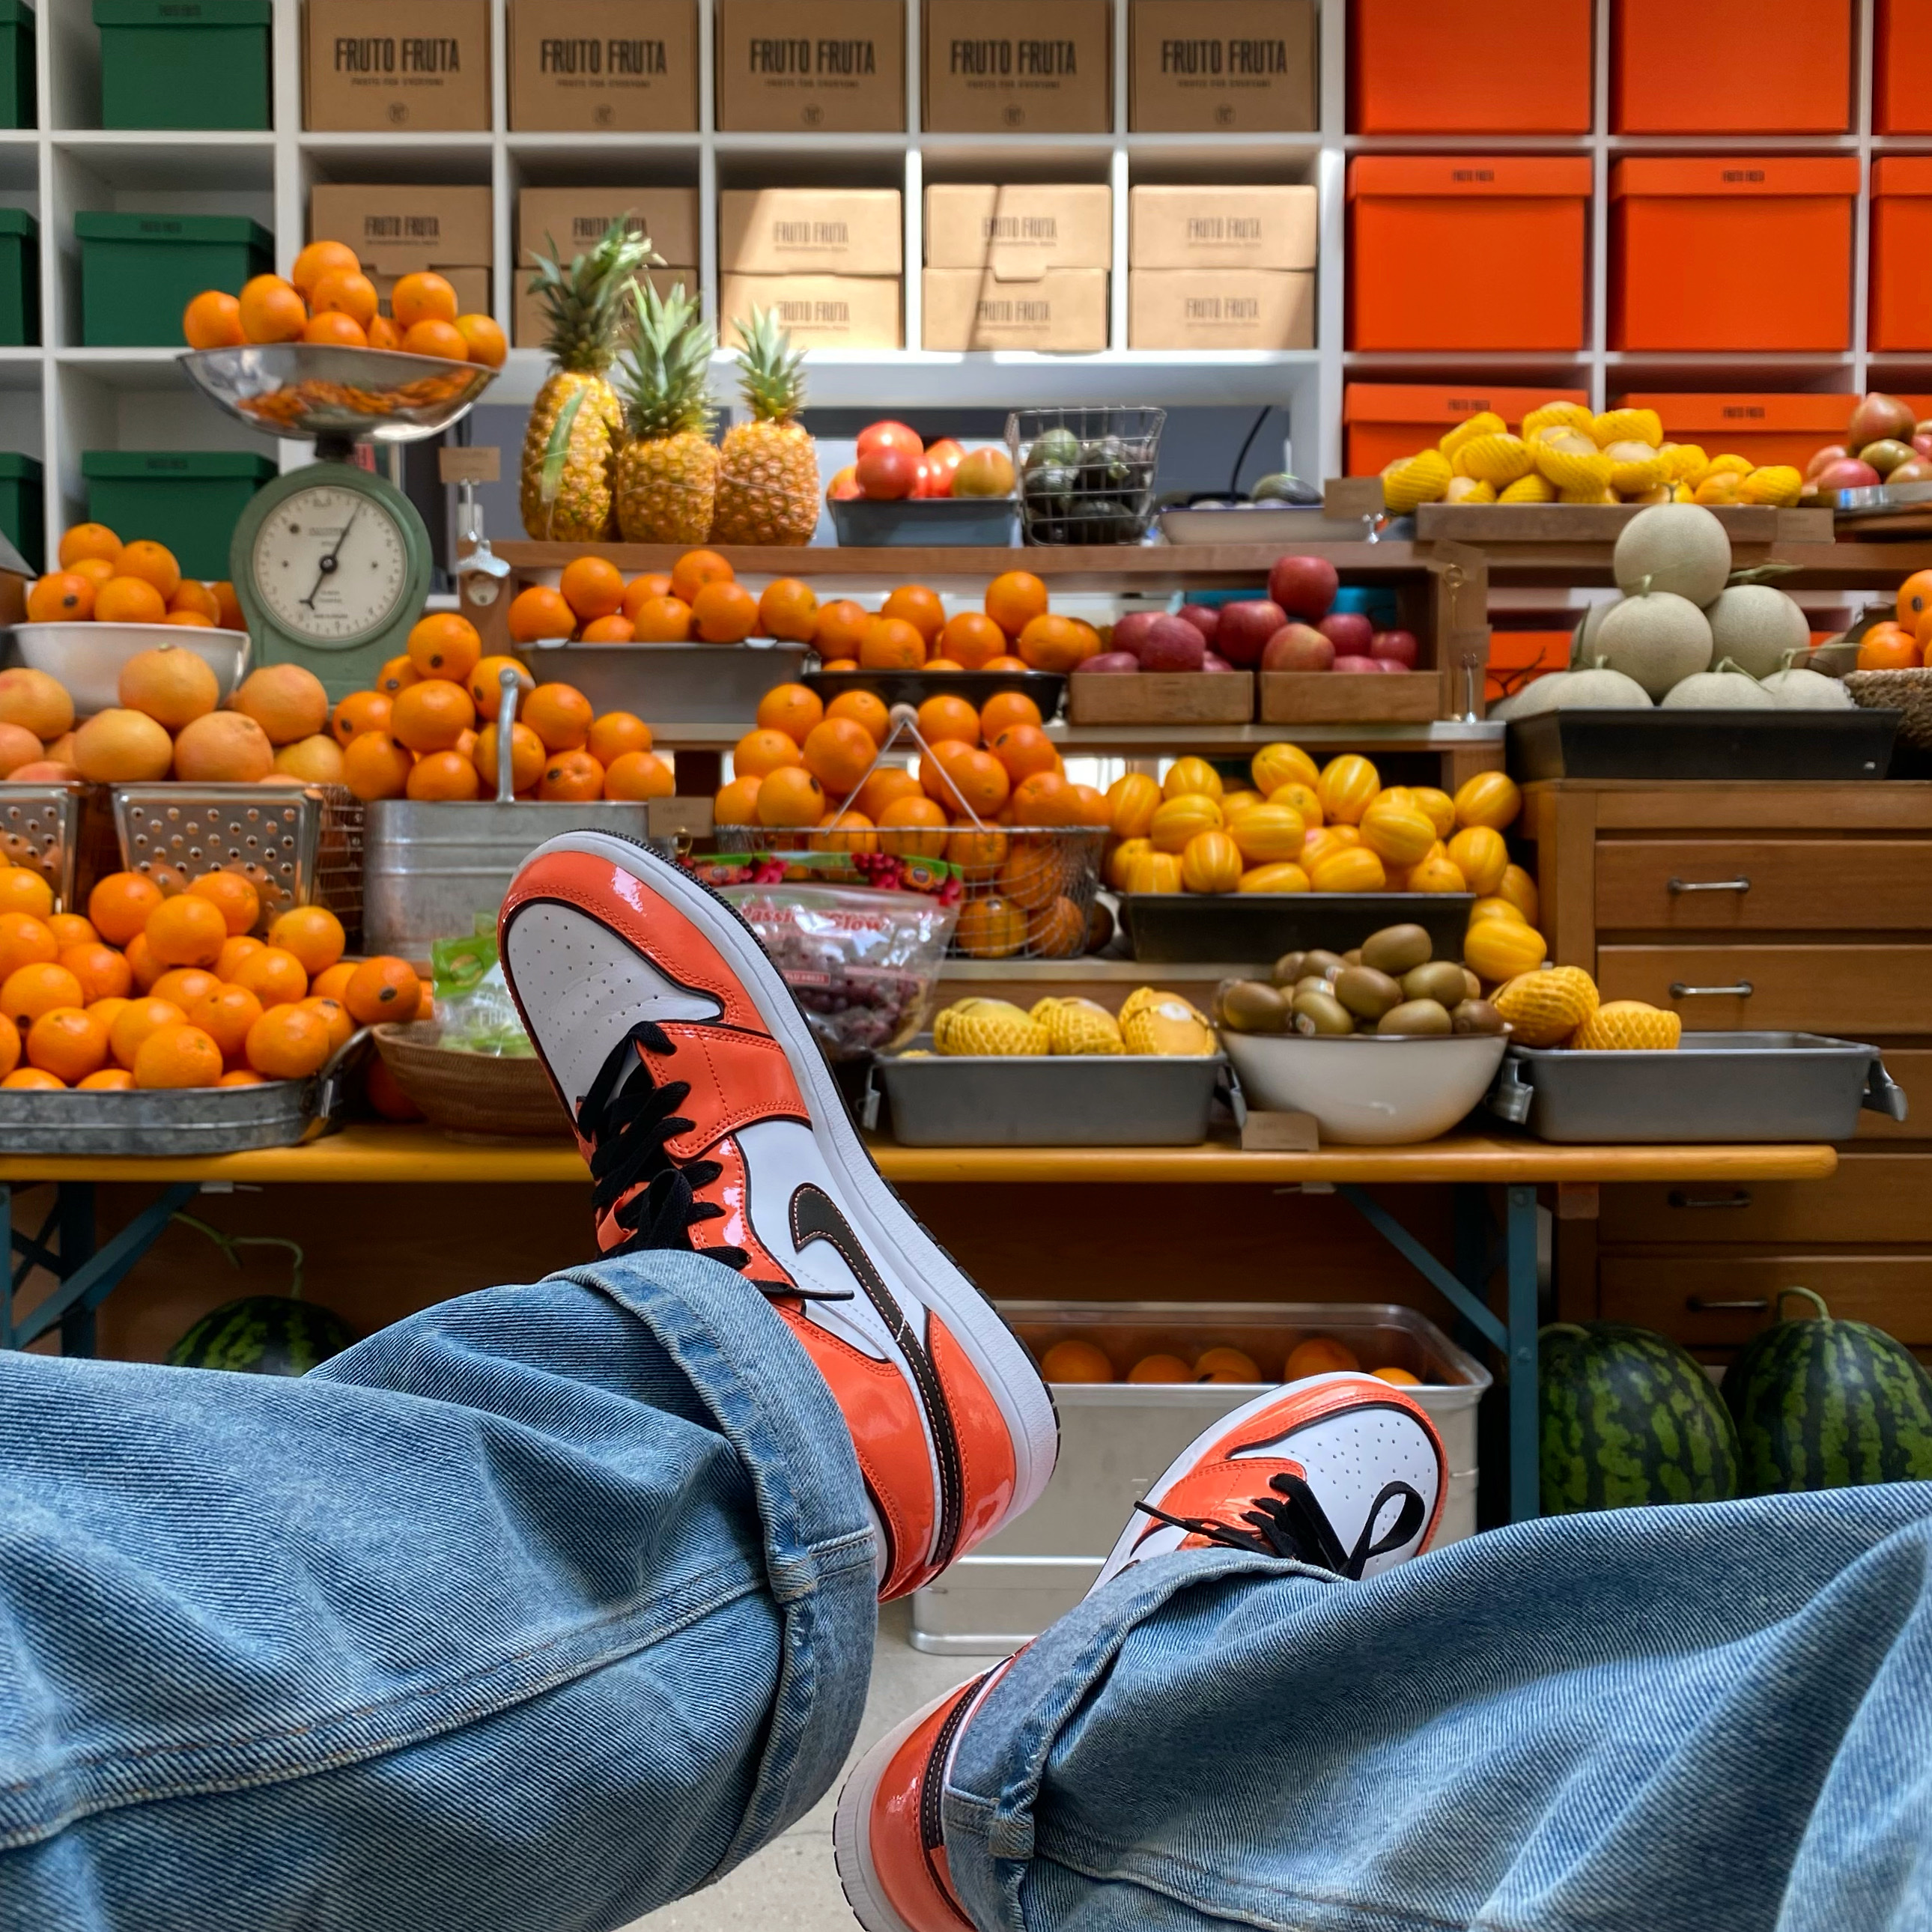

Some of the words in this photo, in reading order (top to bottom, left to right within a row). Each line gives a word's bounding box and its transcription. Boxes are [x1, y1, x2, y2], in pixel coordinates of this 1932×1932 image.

[335, 37, 395, 72] FRUTO
[401, 37, 460, 72] FRUTA
[541, 39, 601, 73] FRUTO
[608, 40, 668, 73] FRUTA
[750, 39, 810, 73] FRUTO
[817, 40, 875, 73] FRUTA
[950, 40, 1010, 73] FRUTO
[1018, 40, 1077, 73] FRUTA
[1161, 40, 1222, 73] FRUTO
[1229, 40, 1288, 73] FRUTA
[365, 216, 401, 236] FRUTO
[404, 216, 440, 236] FRUTA
[773, 222, 810, 243] FRUTO
[812, 222, 848, 243] FRUTA
[981, 216, 1019, 237] FRUTO
[1021, 217, 1057, 237] FRUTA
[1187, 217, 1224, 238] FRUTO
[1227, 217, 1262, 238] FRUTA
[814, 301, 850, 321] FRUTA
[976, 300, 1012, 321] FRUTO
[1015, 301, 1051, 321] FRUTA
[1185, 298, 1221, 318] FRUTO
[1224, 298, 1260, 318] FRUTA
